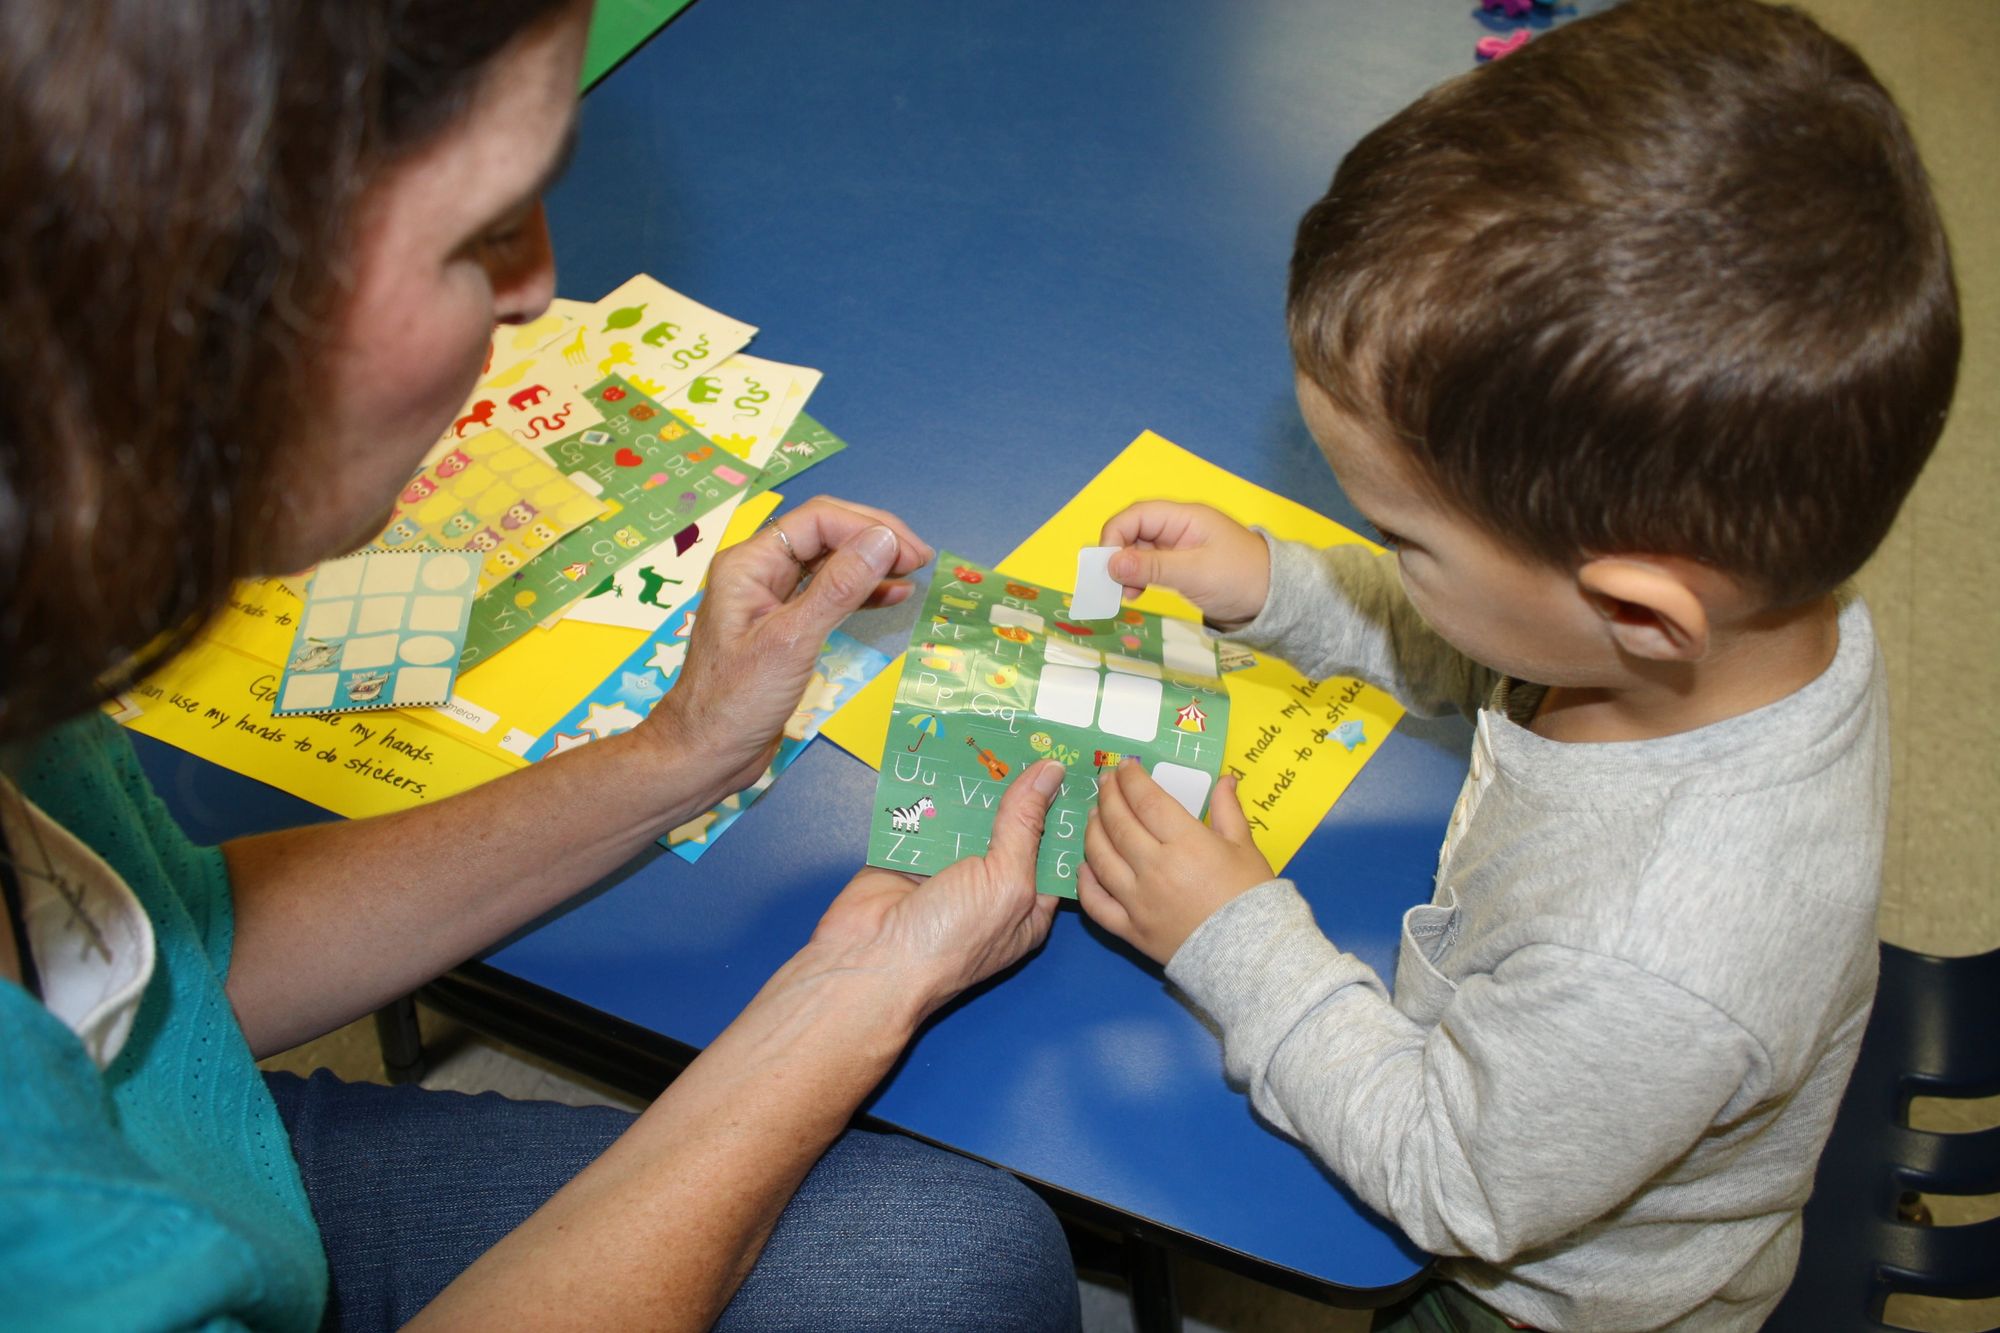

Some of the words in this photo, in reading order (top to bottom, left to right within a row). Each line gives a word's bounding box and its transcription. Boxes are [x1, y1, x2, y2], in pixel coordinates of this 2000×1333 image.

[592, 539, 617, 565] Oo
[249, 674, 278, 703] Go
[350, 723, 377, 747] my
[379, 727, 435, 765] hands.
[447, 703, 481, 723] meron
[916, 671, 953, 706] Pp
[971, 691, 1021, 734] Qq
[1170, 728, 1206, 762] Tt
[1244, 723, 1283, 764] made
[1281, 699, 1312, 720] my
[169, 693, 201, 713] use
[204, 707, 231, 730] my
[234, 713, 287, 743] hands
[293, 737, 312, 752] to
[316, 748, 338, 763] do
[343, 757, 428, 799] stickers.
[1252, 767, 1297, 812] hands
[1295, 746, 1313, 763] to
[1326, 679, 1365, 724] sticke
[894, 755, 937, 786] Uu
[958, 776, 995, 808] Vv
[885, 832, 922, 866] Zz
[1055, 809, 1076, 838] 5
[1055, 850, 1072, 879] 6
